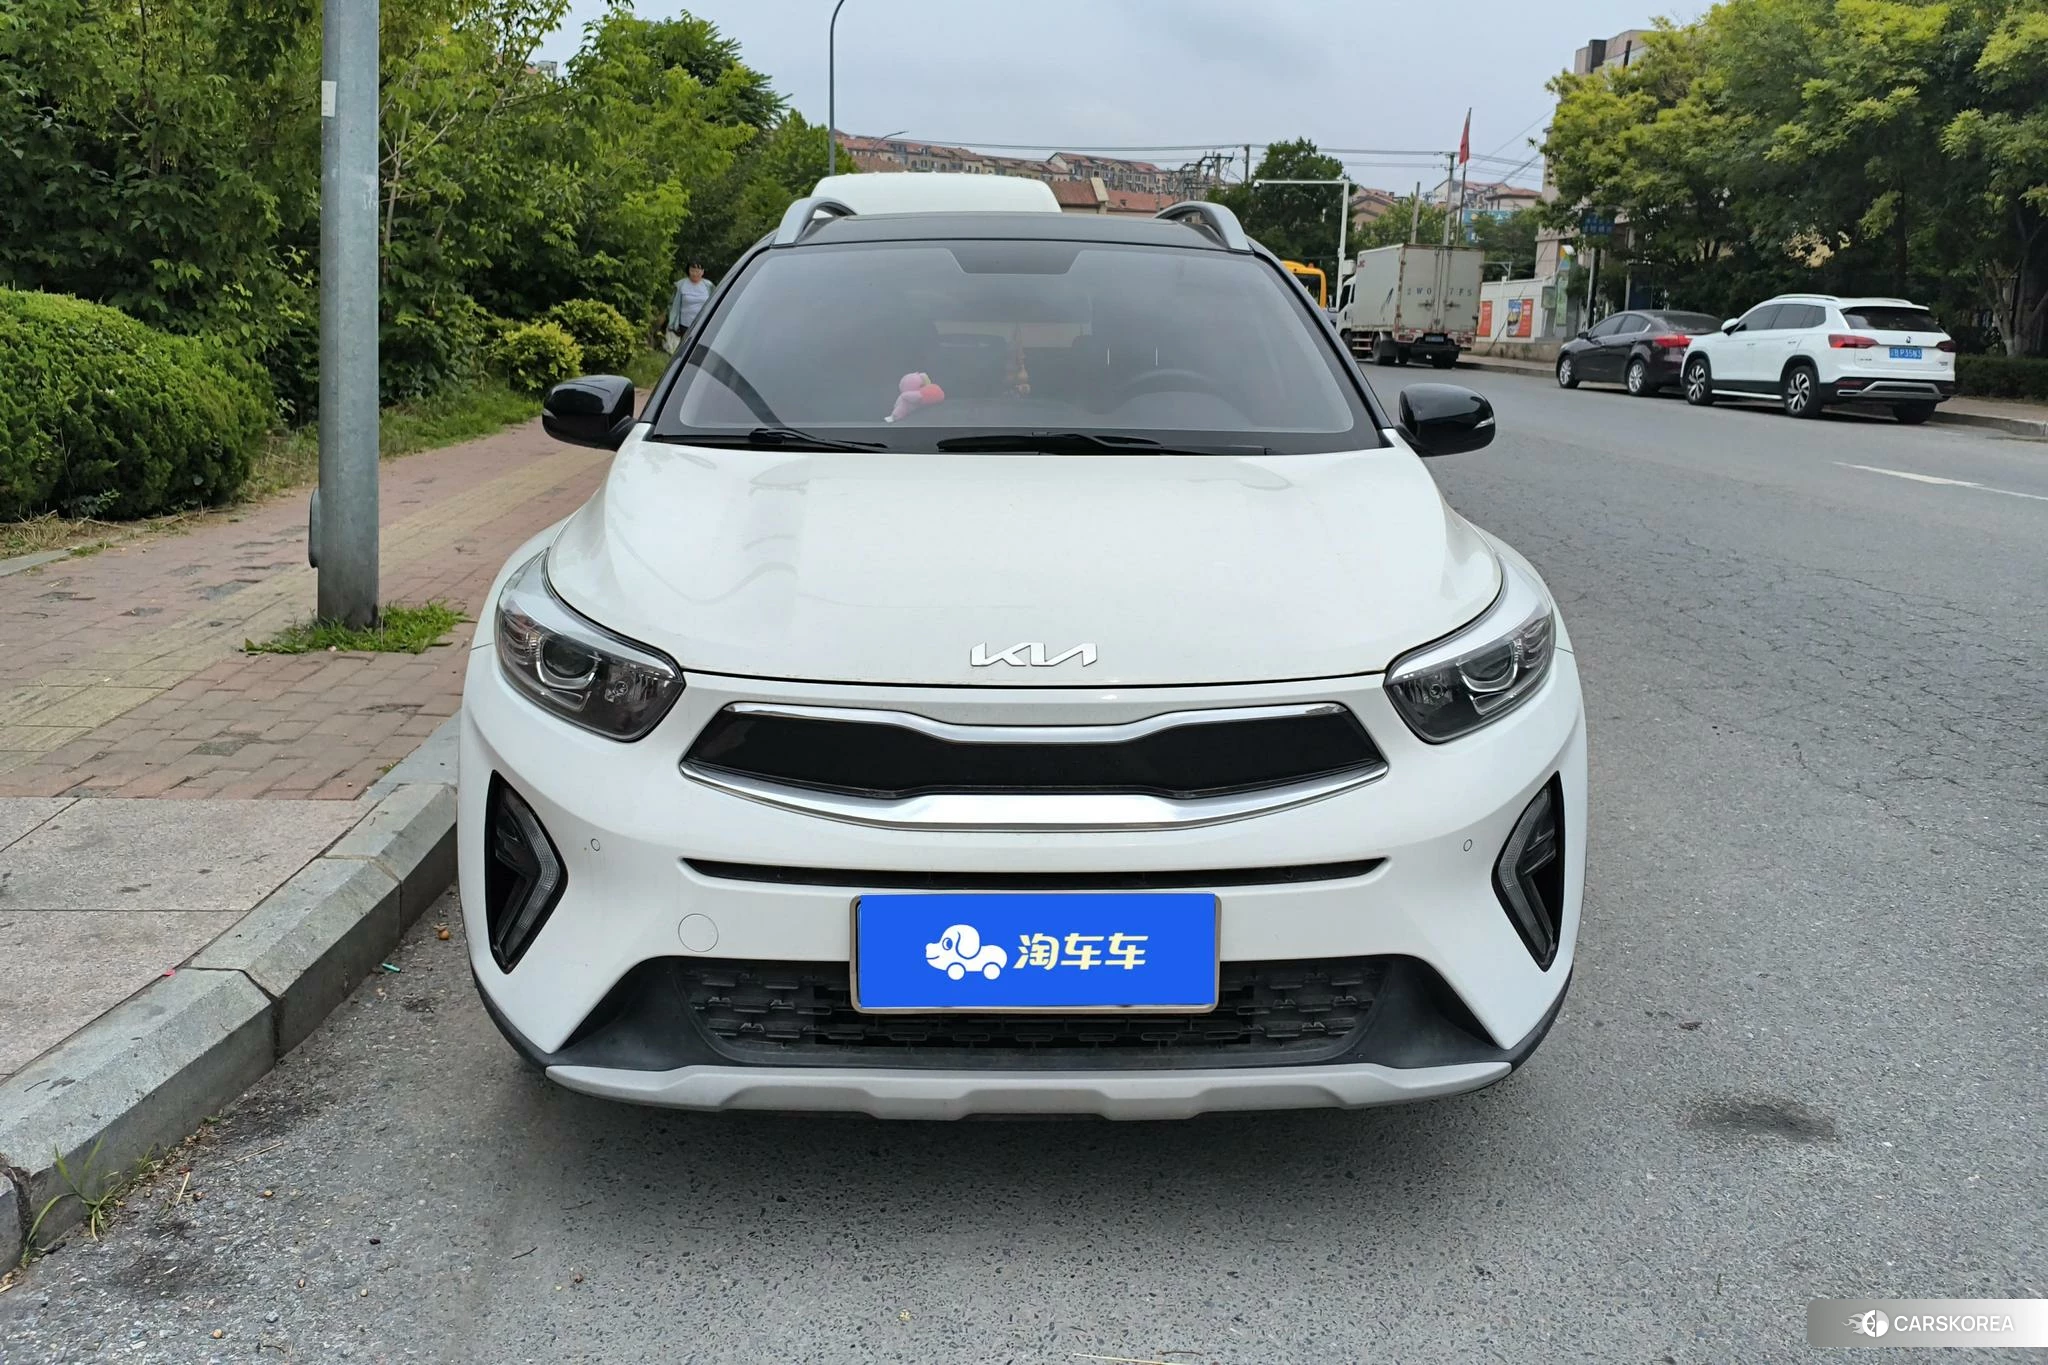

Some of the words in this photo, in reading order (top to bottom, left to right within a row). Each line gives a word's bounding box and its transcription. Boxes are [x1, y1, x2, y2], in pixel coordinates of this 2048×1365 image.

[970, 642, 1098, 667] KIA
[1013, 932, 1149, 971] 淘车车
